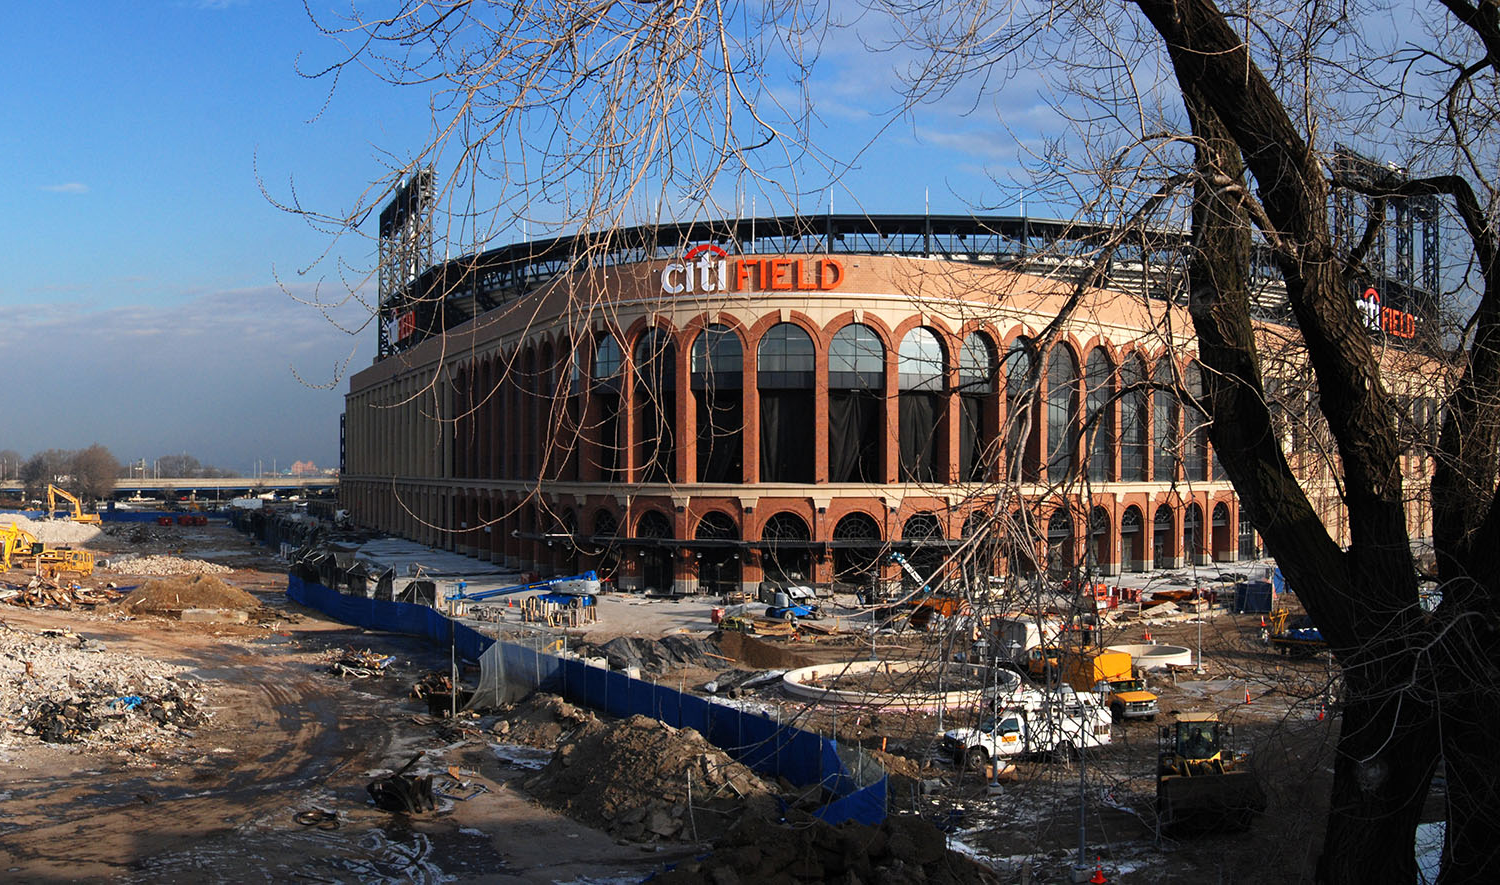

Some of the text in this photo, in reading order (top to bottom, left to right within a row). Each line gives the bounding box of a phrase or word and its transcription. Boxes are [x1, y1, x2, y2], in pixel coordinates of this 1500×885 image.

[661, 252, 845, 294] citi FIELD
[1382, 306, 1415, 339] FIELD
